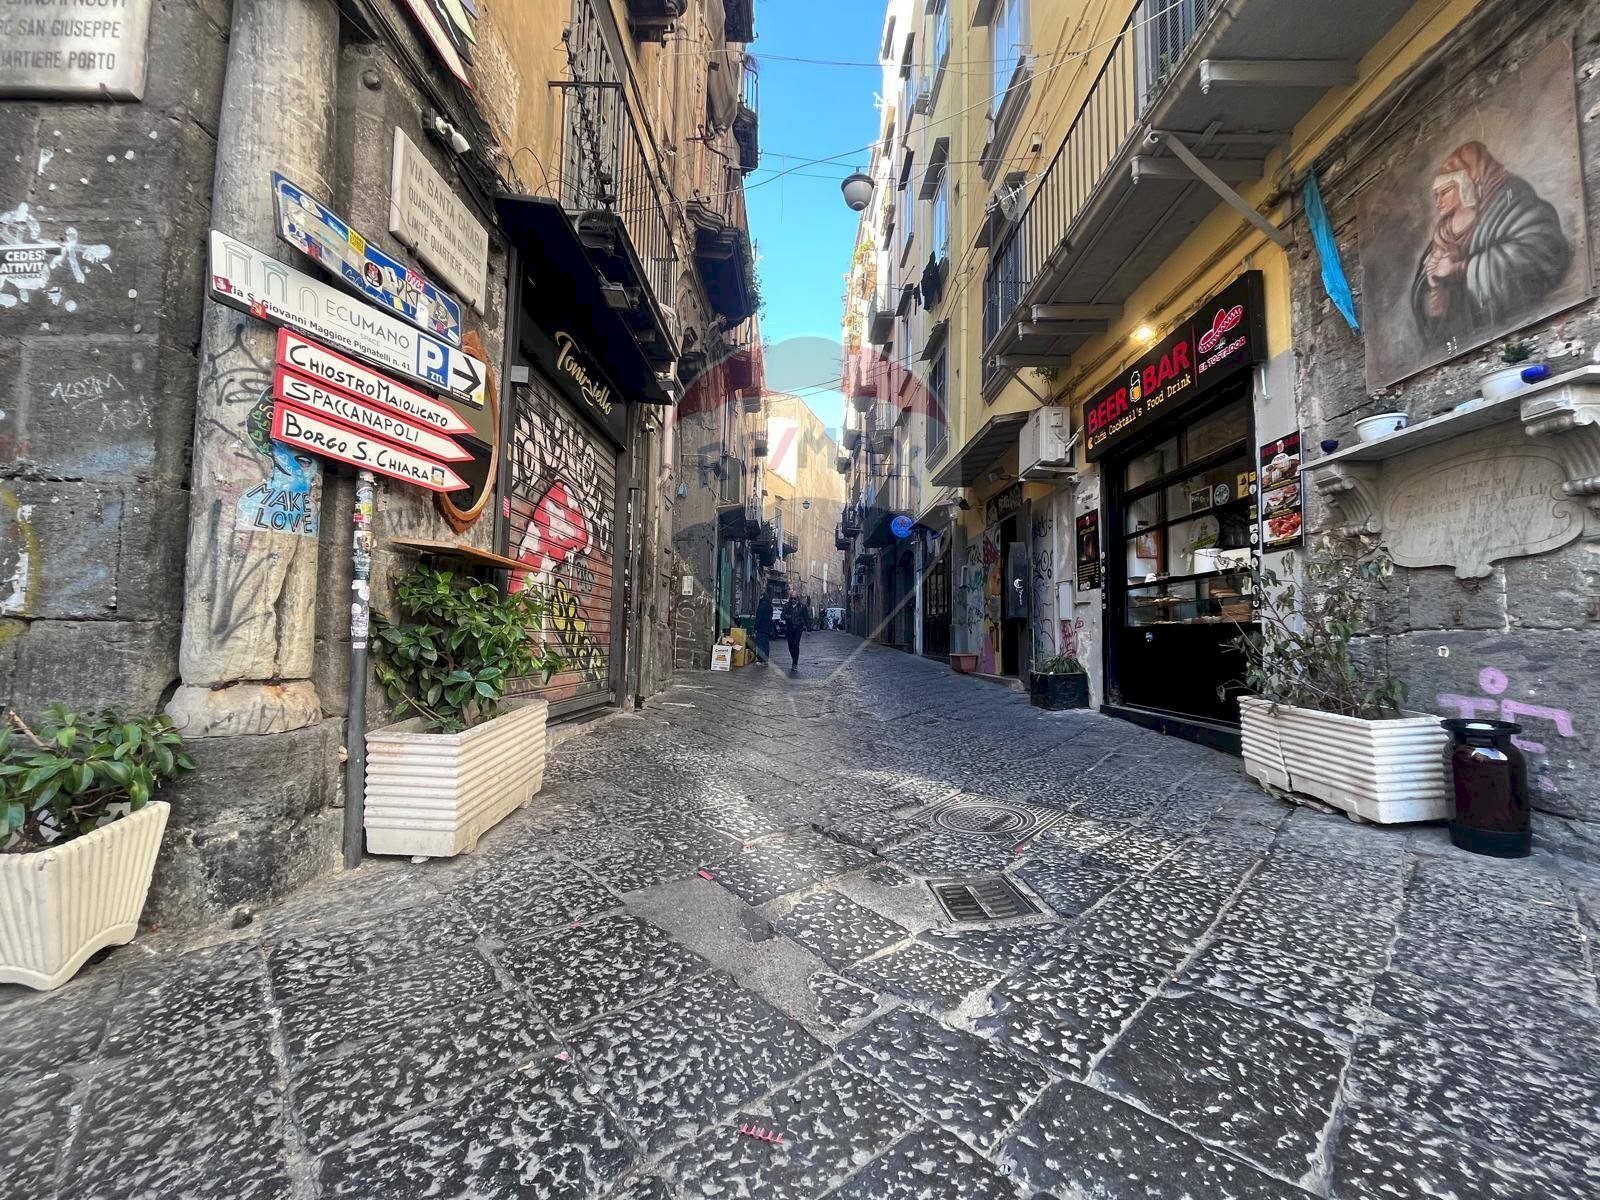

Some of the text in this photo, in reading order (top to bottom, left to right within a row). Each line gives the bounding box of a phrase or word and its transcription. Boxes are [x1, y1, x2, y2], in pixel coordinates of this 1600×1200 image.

[18, 20, 45, 37] SAN
[51, 20, 121, 38] GIUSEPPE
[67, 51, 116, 70] PORTO
[408, 186, 482, 273] QUARTIERE SAN GIUSEPPE
[409, 156, 484, 253] VIA SANTA CHIARA
[0, 262, 44, 274] ATTIVIT
[406, 210, 429, 243] LIMITE
[430, 234, 462, 276] QUARTIERE
[463, 270, 481, 294] PORTO
[261, 299, 307, 325] Giovanni
[309, 320, 352, 345] Maggiore
[353, 340, 391, 362] Pignatelli
[401, 362, 411, 372] 41
[419, 337, 444, 378] P
[430, 371, 445, 384] ZTL
[1088, 340, 1191, 434] BEER BAR
[1108, 407, 1142, 435] Cocktail's
[1146, 390, 1165, 411] Food
[1166, 373, 1192, 398] Drink
[285, 381, 419, 443] SPACCANAPOLI
[284, 412, 429, 481] BORGO S. CHIARA
[246, 482, 311, 513] MAKE
[253, 507, 313, 534] LOVE
